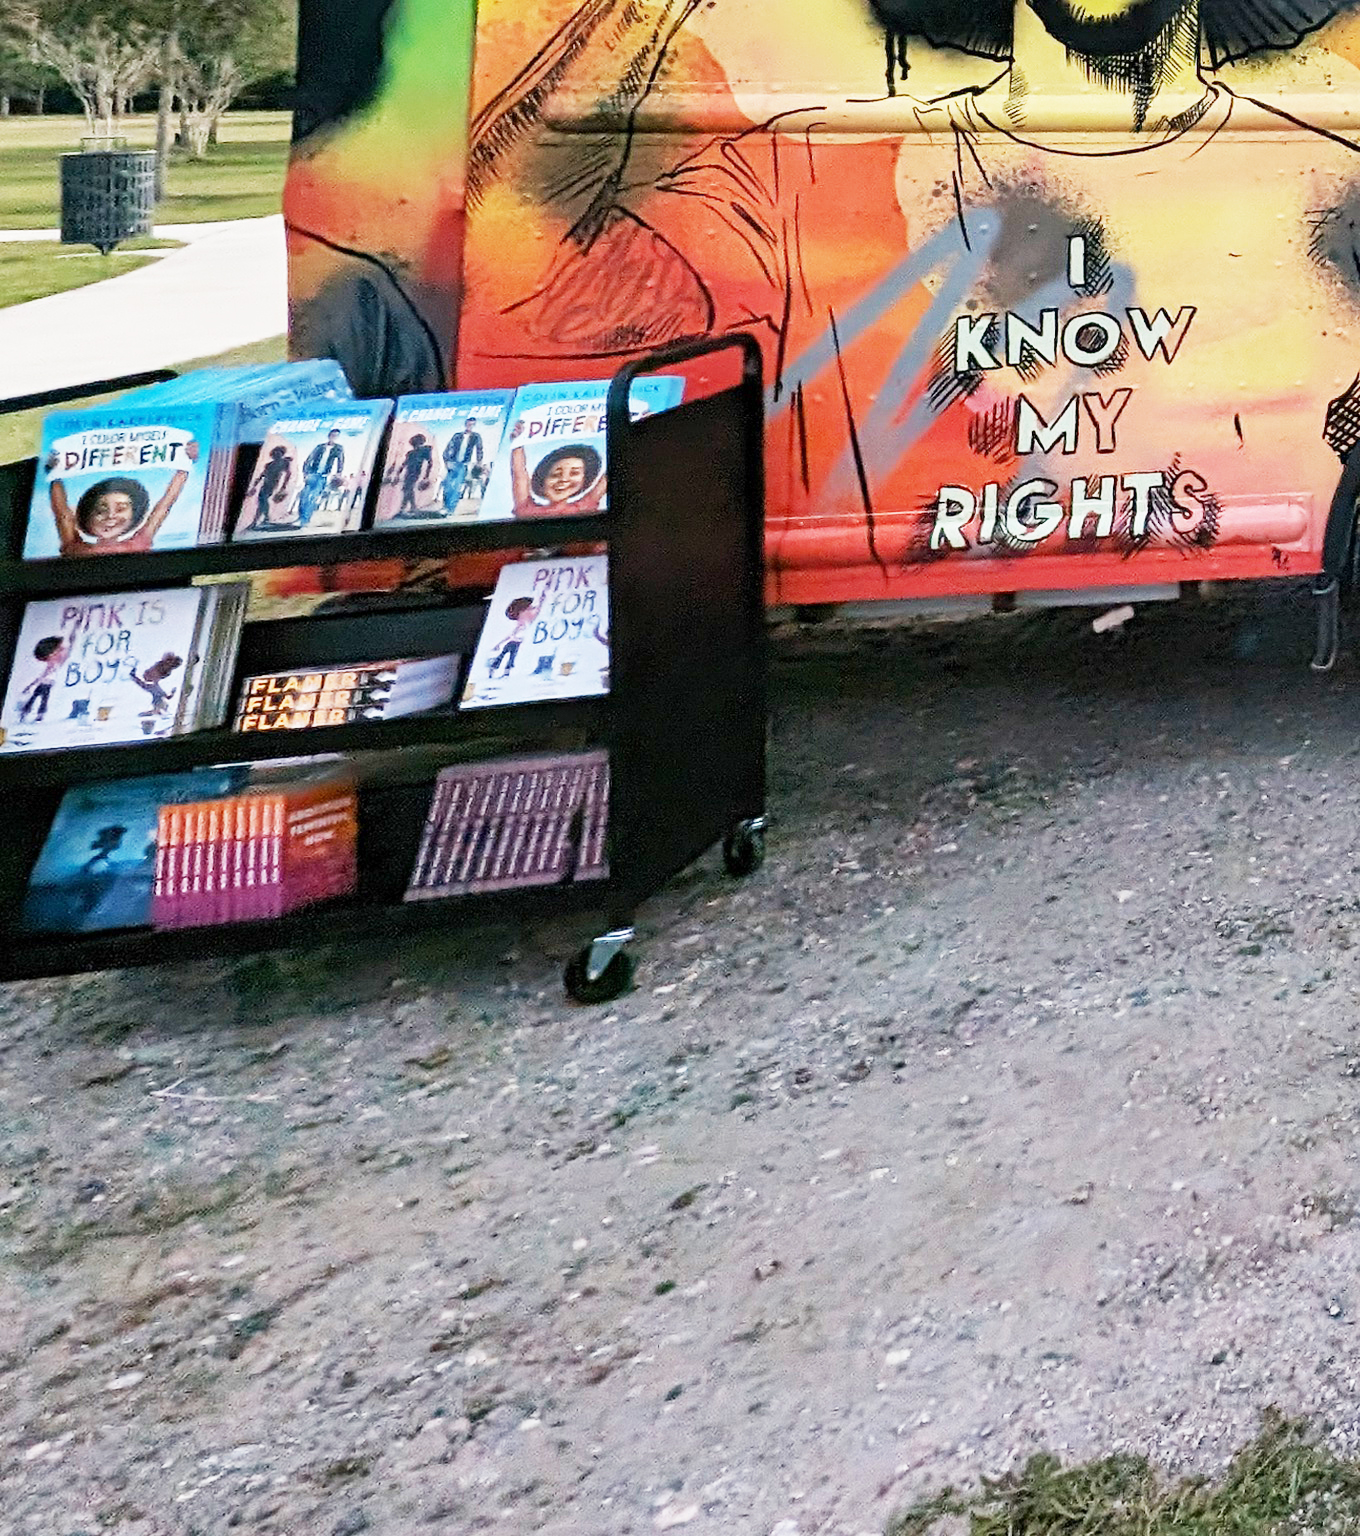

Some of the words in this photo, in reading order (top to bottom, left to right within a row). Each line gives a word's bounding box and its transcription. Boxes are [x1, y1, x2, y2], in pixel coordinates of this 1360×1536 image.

[1067, 235, 1088, 288] I
[955, 306, 1197, 373] KNOW
[528, 415, 608, 439] DIFFERE
[1015, 388, 1133, 455] MY
[65, 442, 183, 471] DIFFERENT
[929, 468, 1209, 551] RIGHTS
[533, 566, 593, 592] PINK
[60, 603, 126, 631] PINK
[136, 599, 166, 626] IS
[65, 655, 139, 687] BOYS
[251, 672, 359, 695] FLAMER
[246, 688, 351, 713] FLAMER
[242, 708, 346, 732] FLAMER
